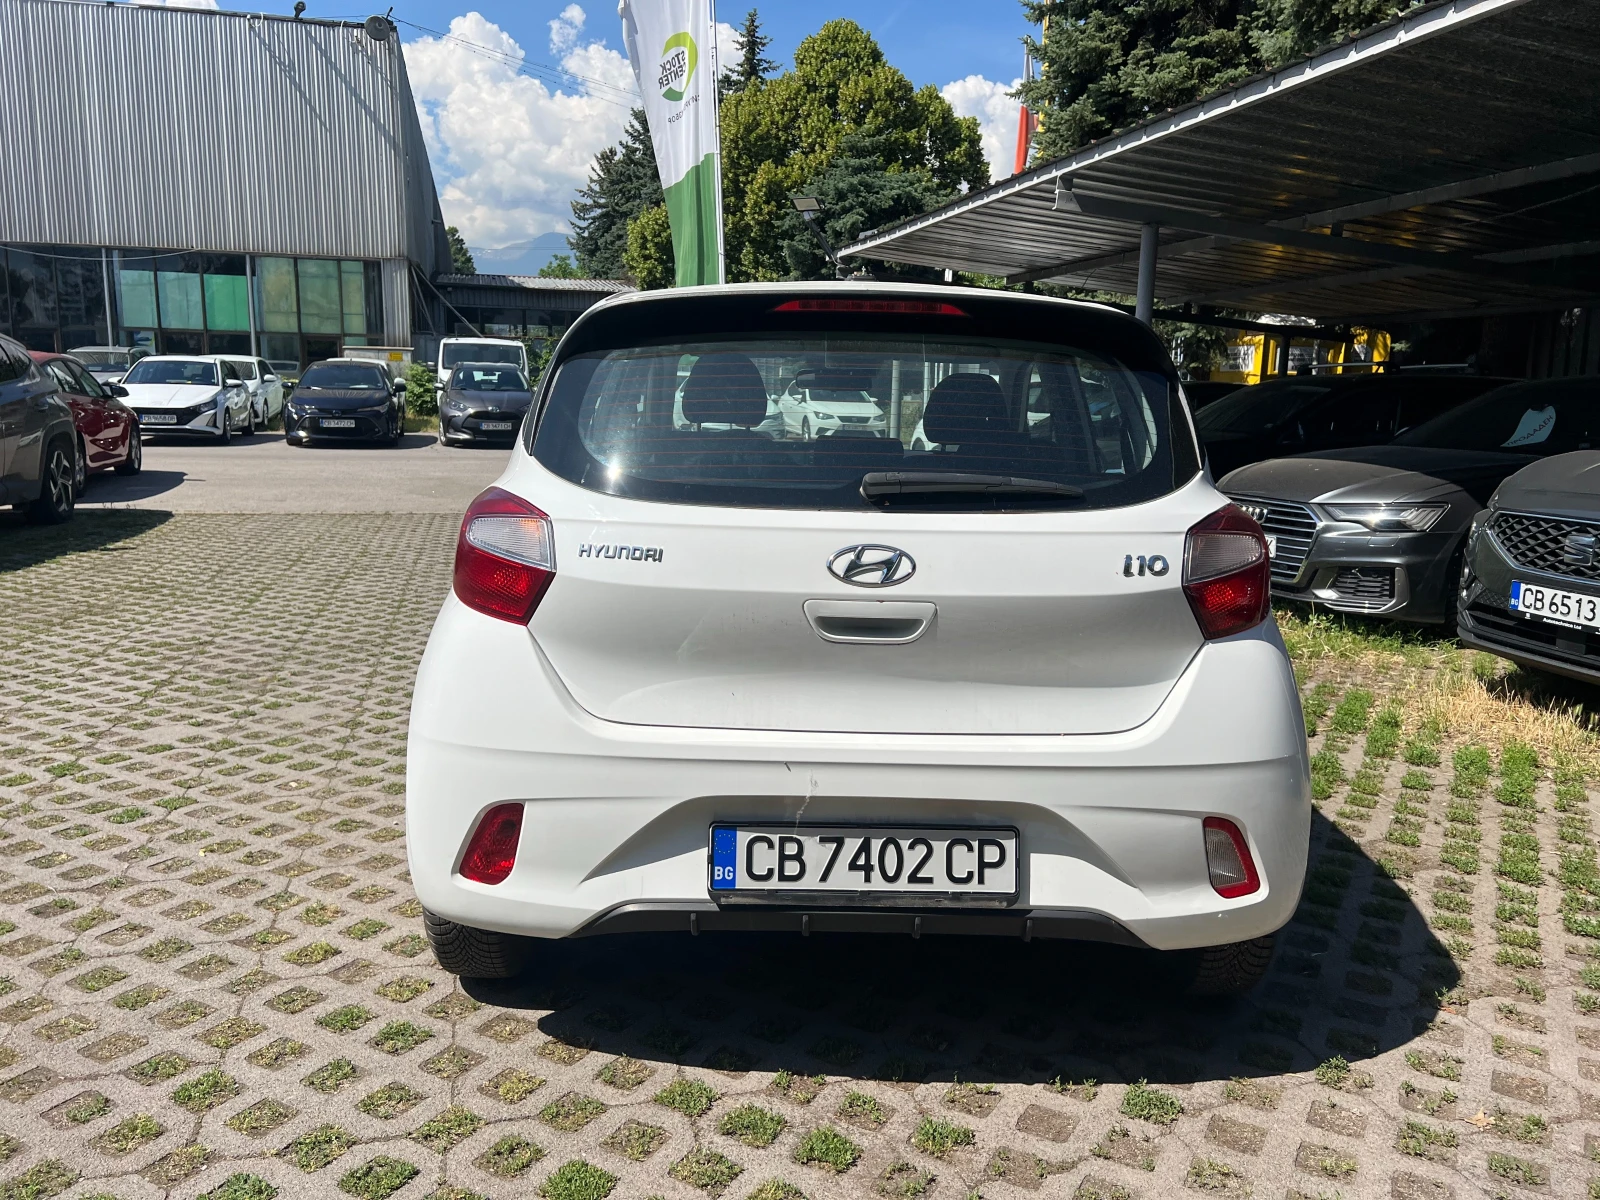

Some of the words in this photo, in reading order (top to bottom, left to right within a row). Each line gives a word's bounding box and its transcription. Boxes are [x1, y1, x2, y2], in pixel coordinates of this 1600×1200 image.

[1507, 415, 1554, 446] ПРОДАДЕН
[579, 543, 664, 563] HYUNDAI
[1123, 554, 1170, 578] i10
[1511, 597, 1519, 606] BG
[1522, 587, 1545, 612] CB
[1549, 592, 1597, 622] 6513
[714, 866, 734, 881] BG
[745, 835, 806, 882] CB
[818, 836, 934, 884] 7402
[945, 837, 1007, 885] CP
